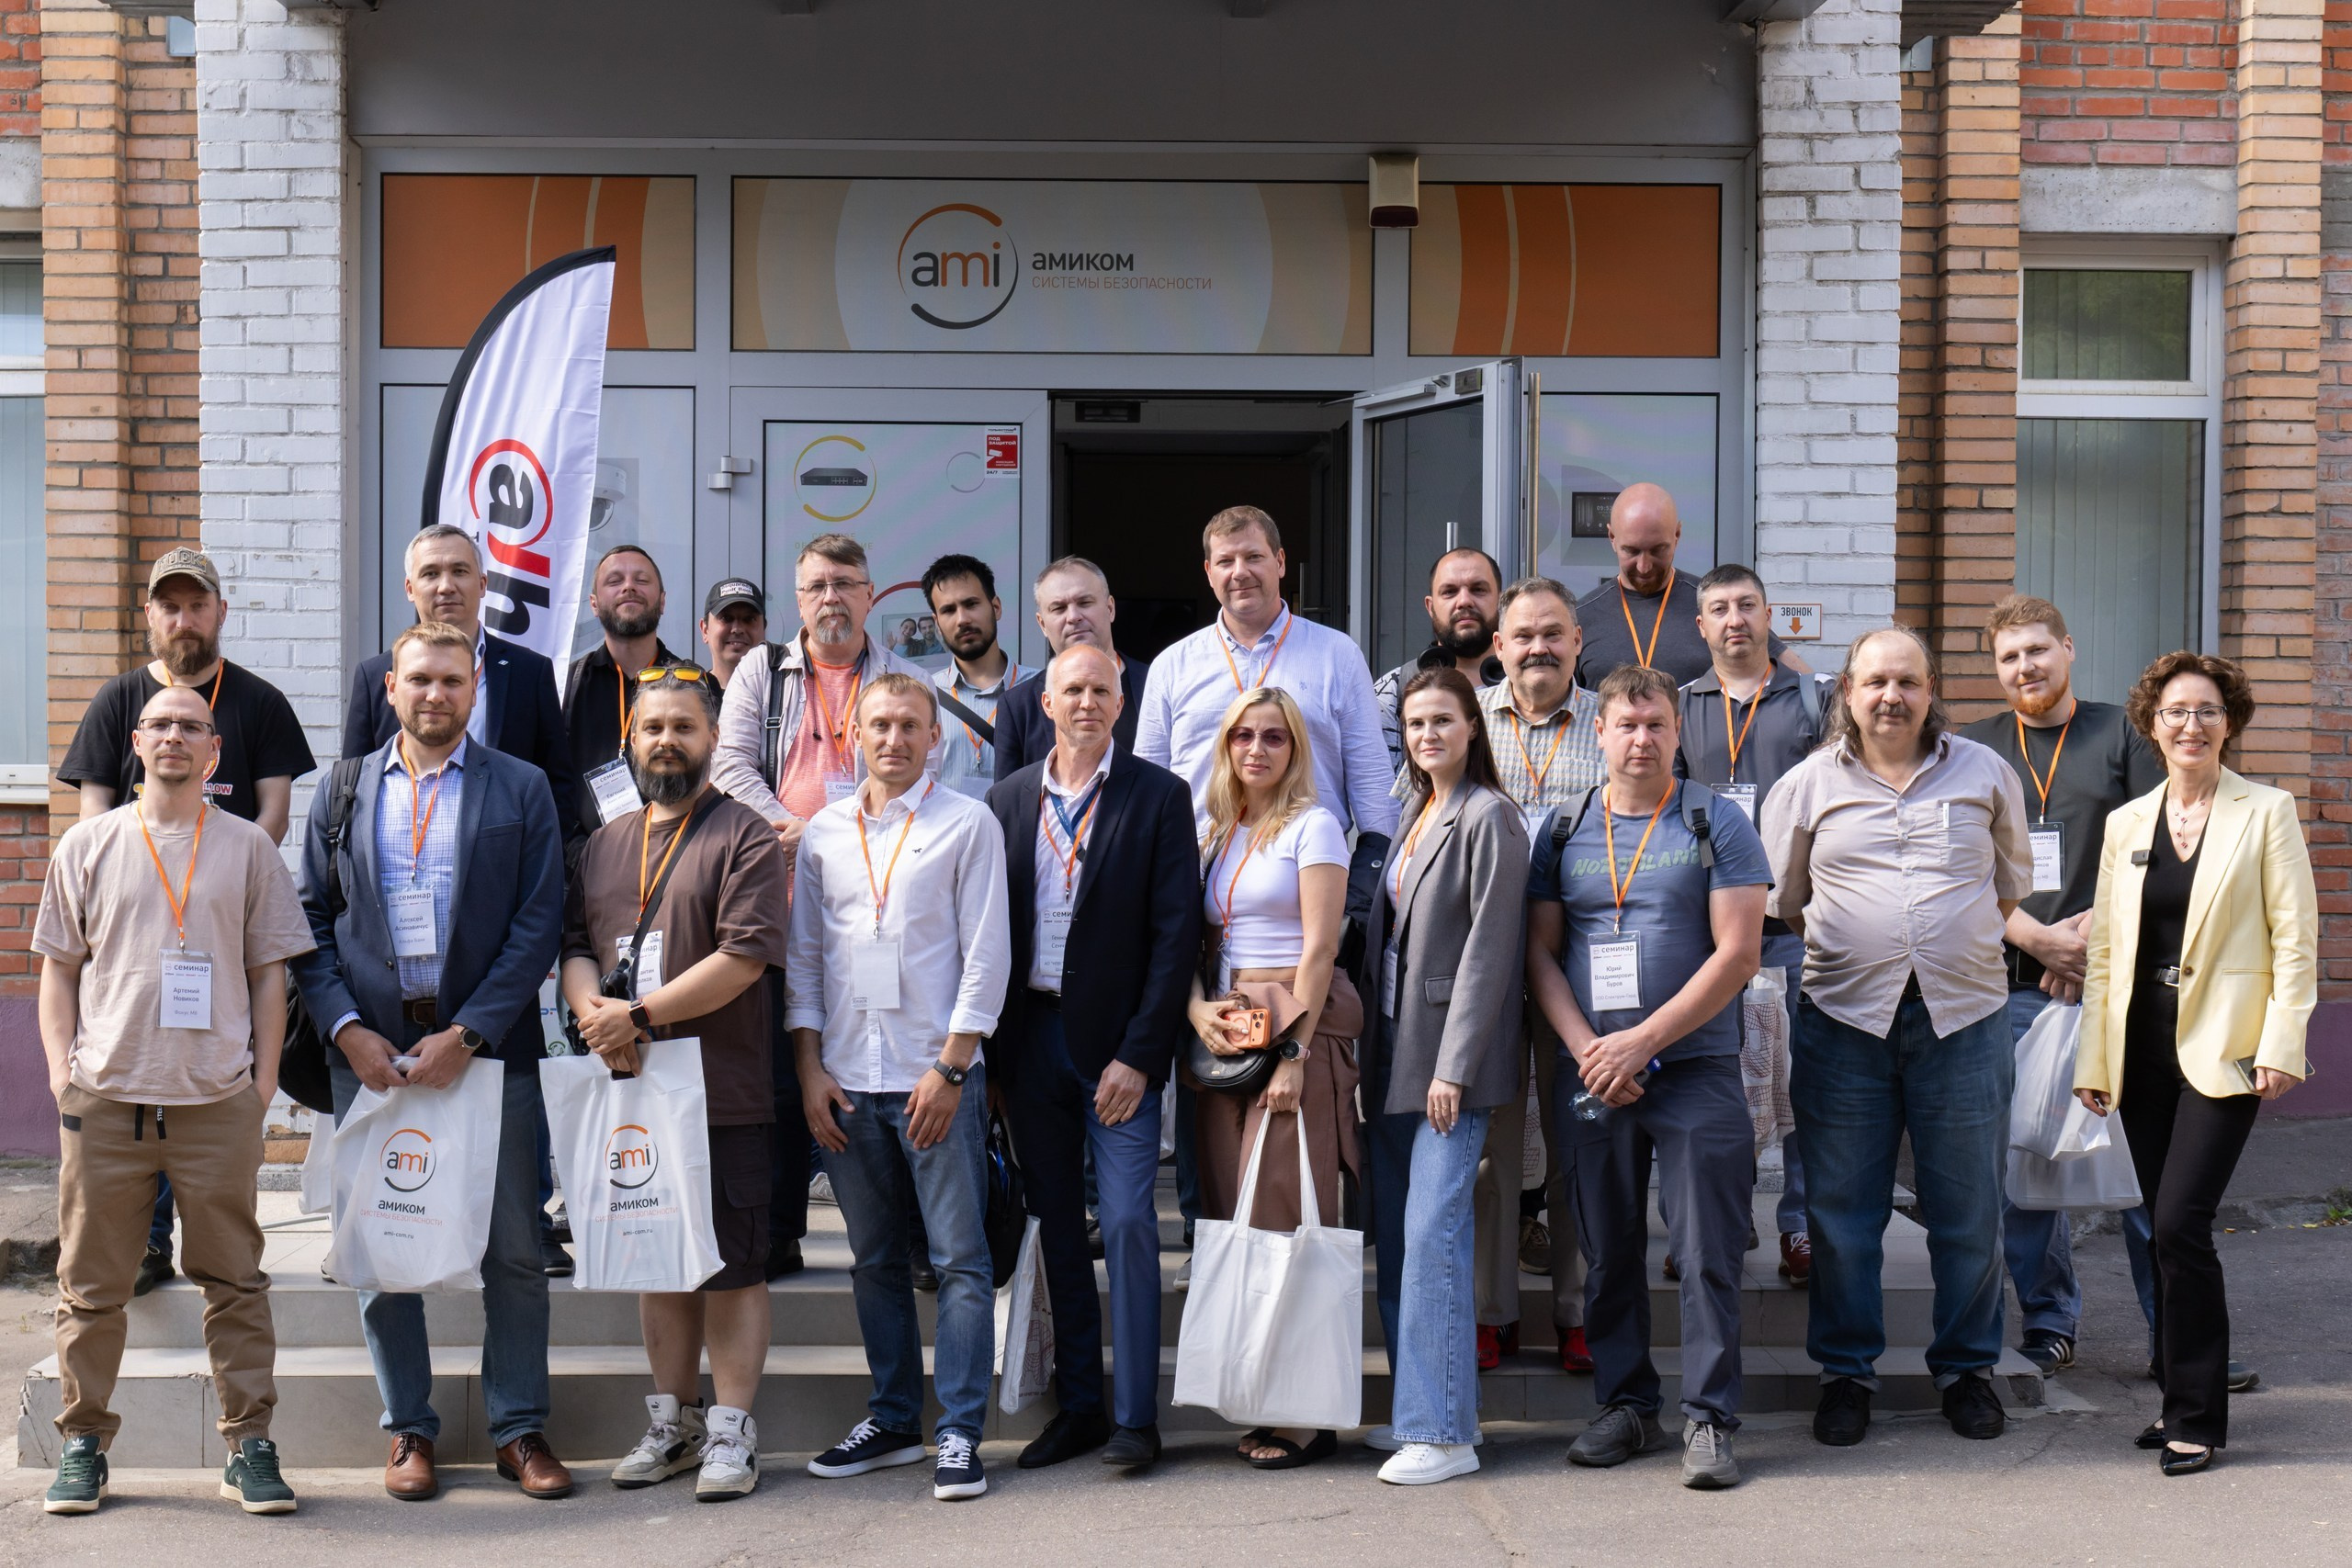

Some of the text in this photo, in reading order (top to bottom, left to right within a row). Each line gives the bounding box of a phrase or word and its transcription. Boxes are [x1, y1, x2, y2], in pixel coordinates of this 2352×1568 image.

[911, 242, 1001, 288] ami
[1032, 253, 1134, 272] амиком
[1032, 276, 1212, 290] СИСТЕМЫ БЕЗОПАСНОСТИ
[1781, 606, 1813, 616] ЗВОНОК
[599, 767, 627, 783] семинар
[398, 892, 432, 901] семинар
[1601, 944, 1634, 953] семинар
[175, 964, 209, 973] семинар
[386, 1151, 429, 1174] ami
[609, 1143, 650, 1170] ami
[378, 1200, 425, 1215] амиком
[610, 1197, 659, 1212] амиком
[359, 1208, 443, 1227] СИСТЕМЫ БЕЗОПАСНОСТИ
[594, 1206, 679, 1223] СИСТЕМЫ БЕЗОПАСНОСТИ
[383, 1231, 414, 1239] ami-com.ru
[622, 1228, 653, 1236] ami-com.ru
